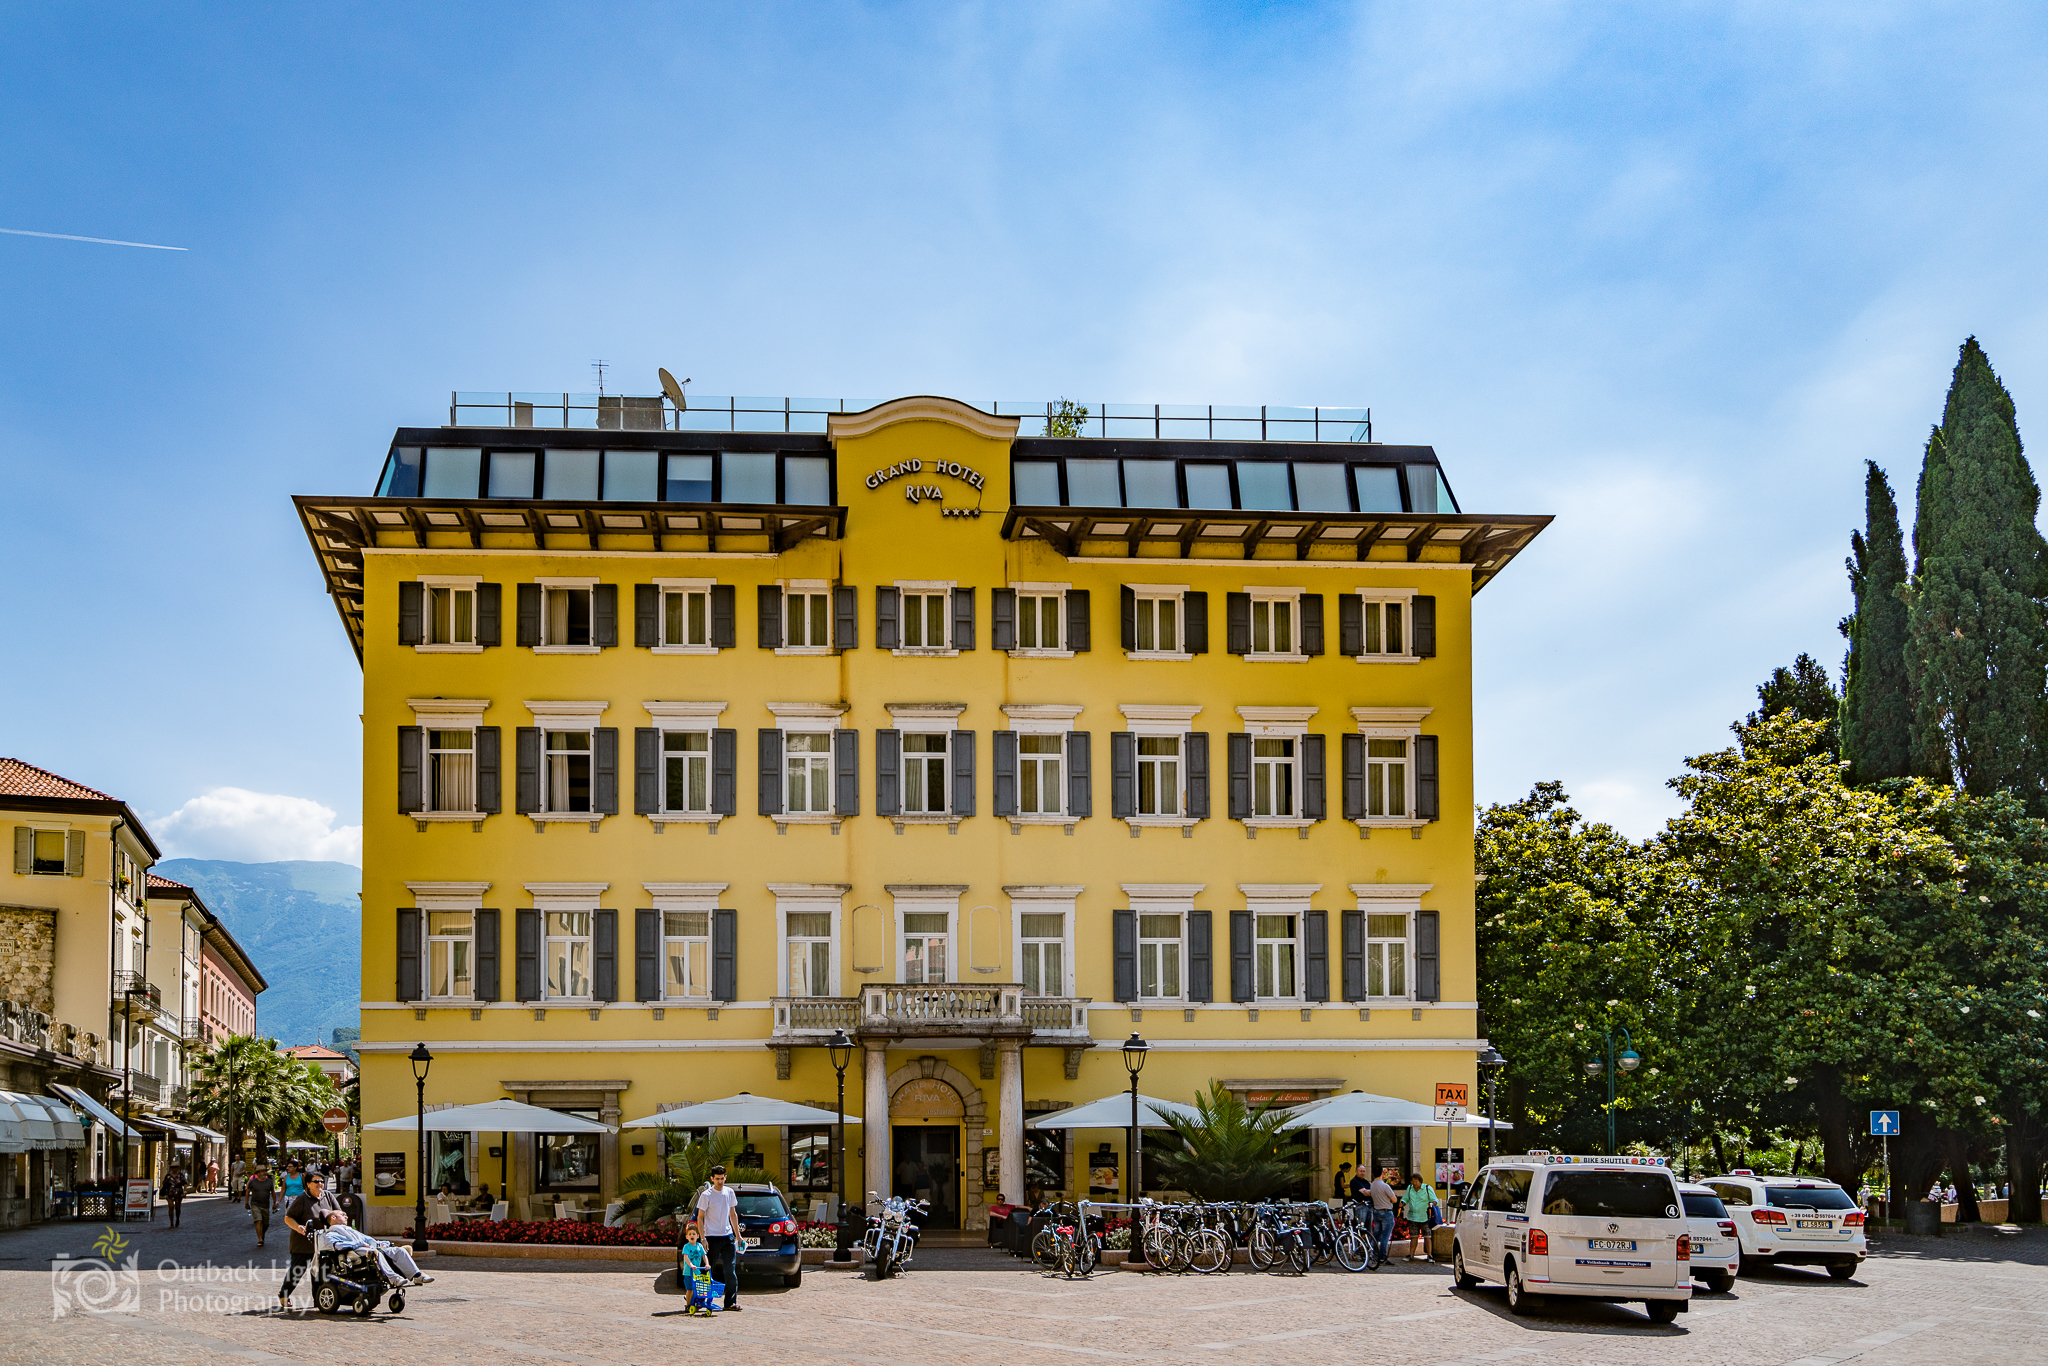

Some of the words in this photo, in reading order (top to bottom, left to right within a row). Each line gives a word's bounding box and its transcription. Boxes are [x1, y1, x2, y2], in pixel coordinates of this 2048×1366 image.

[865, 458, 922, 490] GRAND
[936, 459, 985, 490] HOTEL
[906, 484, 943, 504] RIVA
[893, 1080, 927, 1109] GRAND
[932, 1081, 960, 1107] HOTEL
[914, 1094, 941, 1102] RIVA
[1438, 1089, 1466, 1100] TAXI
[1600, 1157, 1630, 1165] SHUTTLE
[1594, 1240, 1604, 1248] FC
[1606, 1240, 1631, 1249] 072RJ
